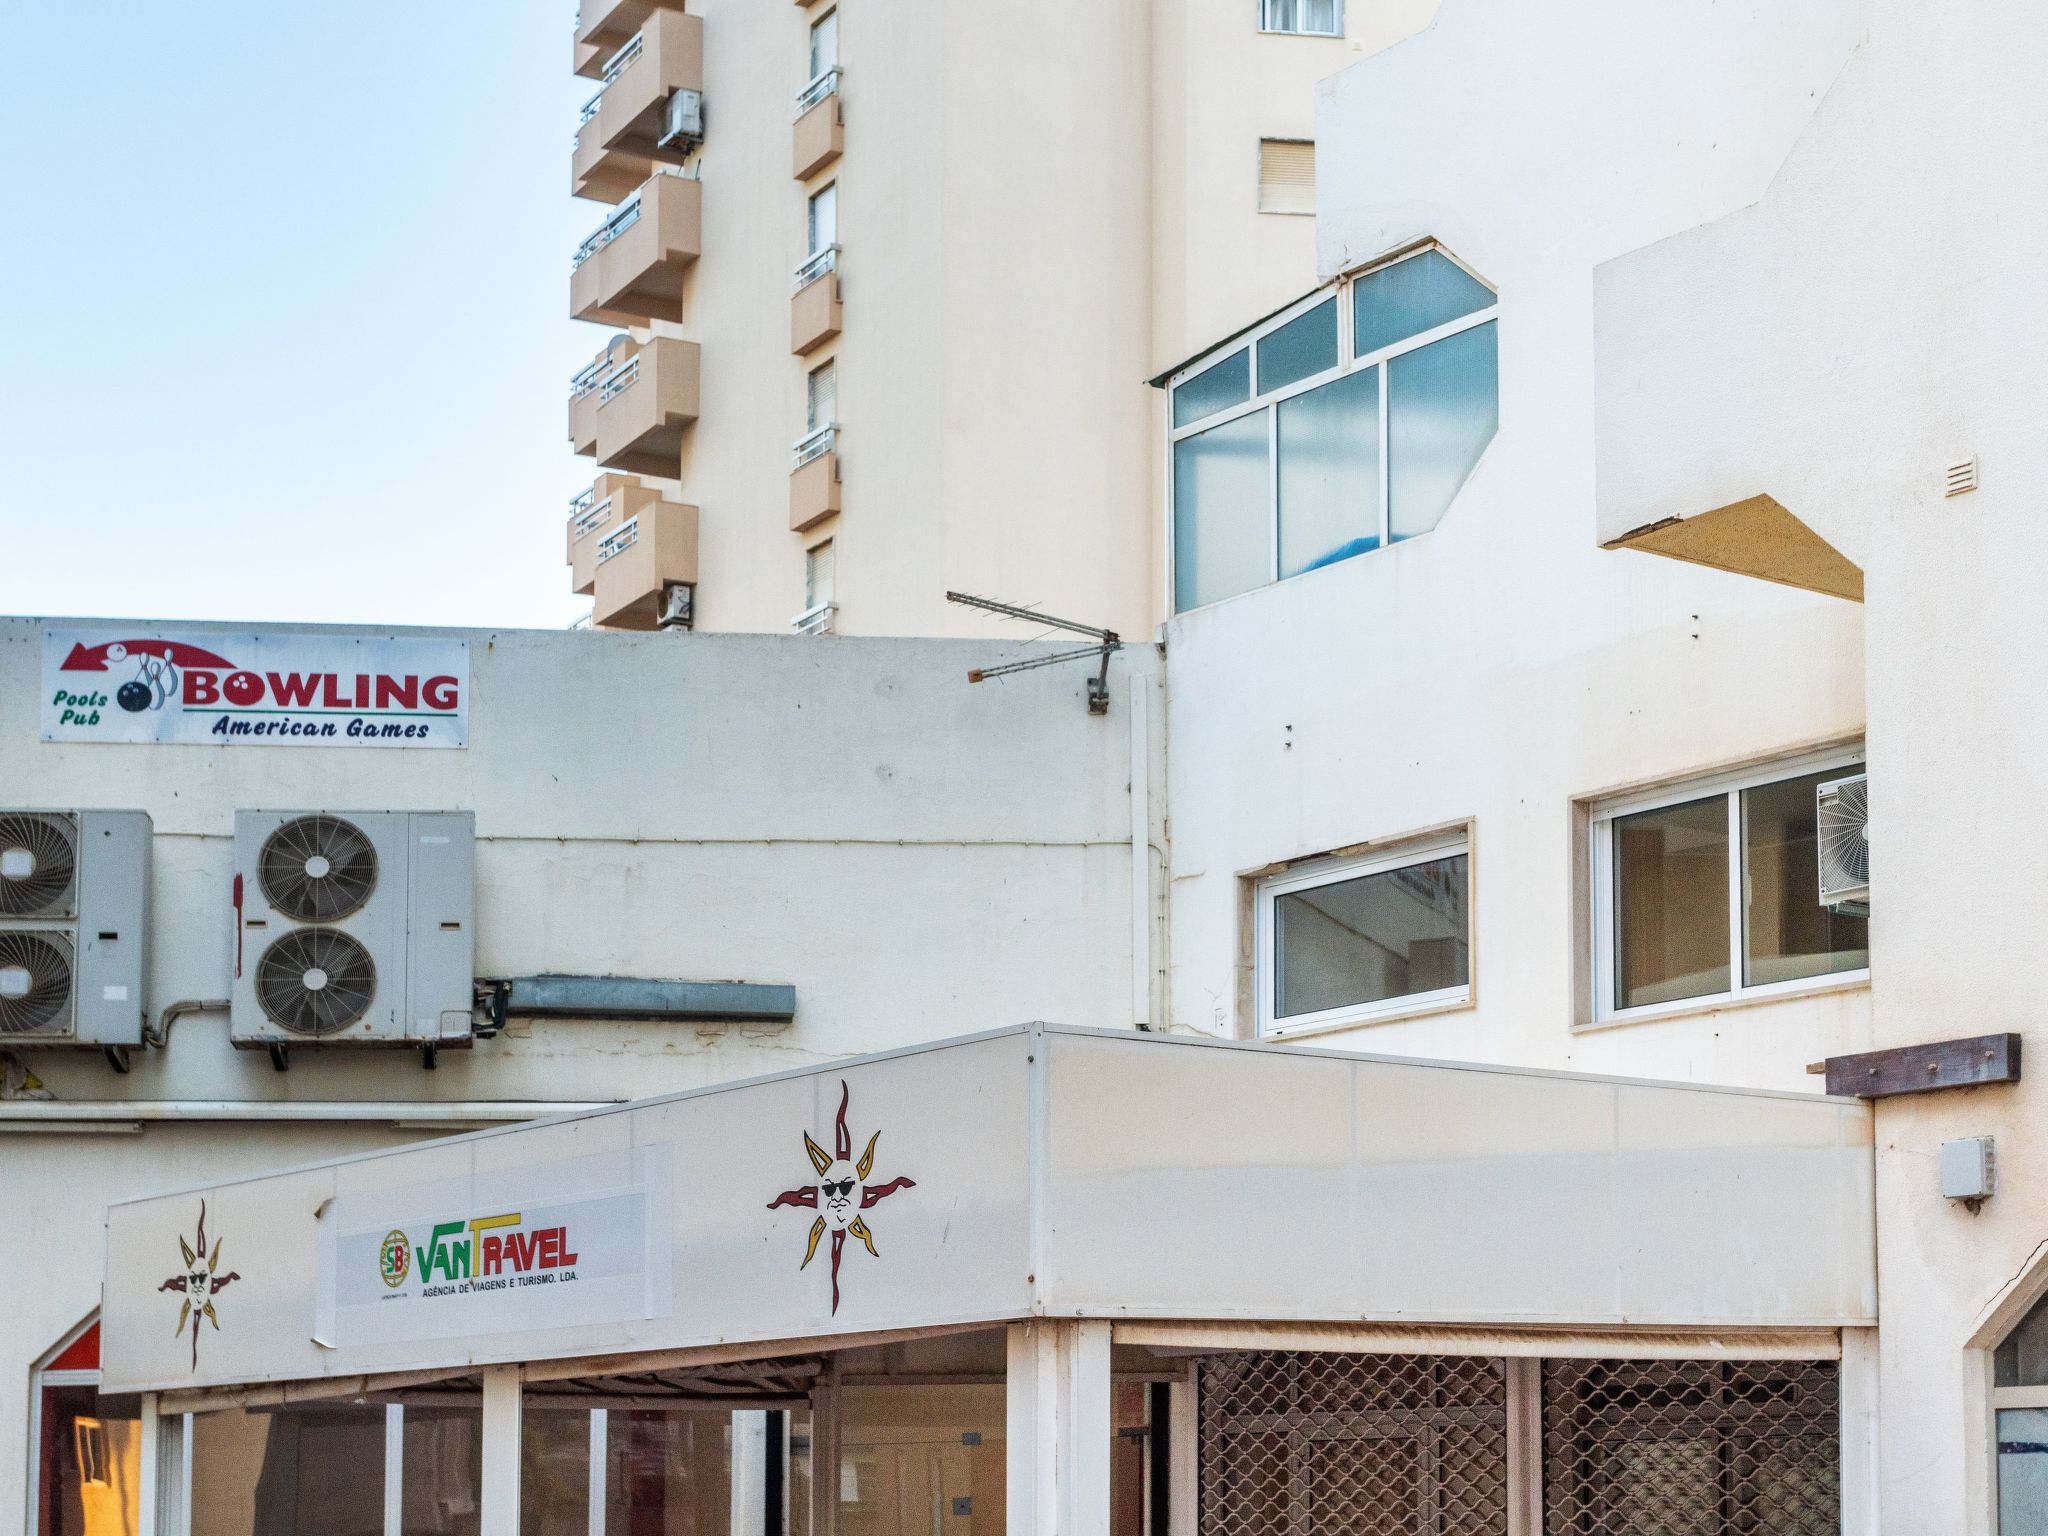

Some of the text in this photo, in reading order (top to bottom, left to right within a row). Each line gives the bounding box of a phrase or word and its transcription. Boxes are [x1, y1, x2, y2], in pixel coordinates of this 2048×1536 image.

[52, 689, 108, 708] Pools
[183, 670, 459, 711] BOWLING
[60, 709, 101, 726] Pub
[212, 715, 431, 739] American Games
[386, 1245, 404, 1274] SB
[459, 1283, 469, 1293] DE
[472, 1279, 507, 1292] VIAGENS
[509, 1279, 515, 1288] E
[518, 1273, 557, 1286] TURISMO.
[560, 1271, 579, 1282] LDA.
